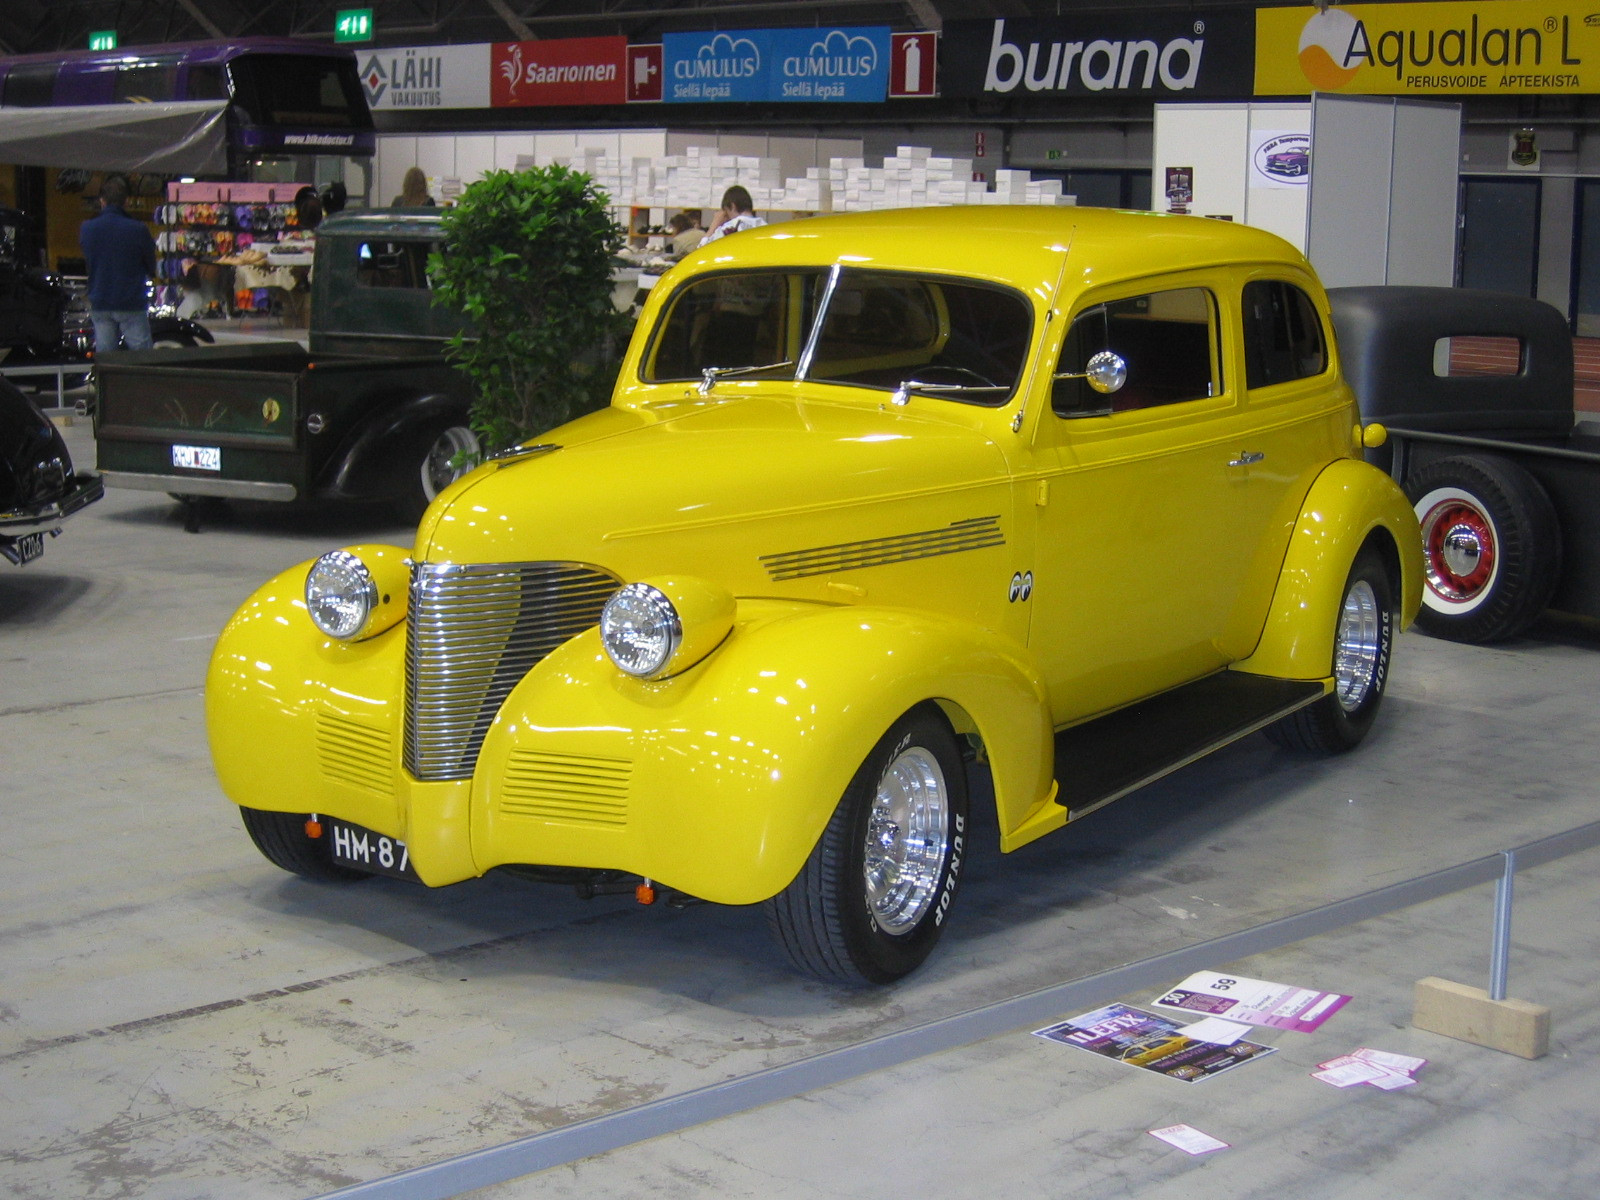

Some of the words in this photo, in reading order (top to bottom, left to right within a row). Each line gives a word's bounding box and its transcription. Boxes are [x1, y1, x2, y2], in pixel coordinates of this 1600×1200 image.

[1561, 15, 1581, 65] L
[391, 50, 441, 89] LÄHI
[525, 63, 616, 84] Saarioinen
[674, 57, 755, 78] CUMULUS
[782, 56, 872, 77] CUMULUS
[673, 83, 701, 98] Siellä
[702, 82, 731, 100] lepää
[782, 81, 812, 97] Siellä
[814, 81, 845, 100] lepää
[1406, 75, 1487, 88] PERUSVOIDE
[1499, 74, 1580, 88] APTEEKISTA
[391, 92, 441, 106] VAKUUTUS
[1375, 611, 1390, 693] DUNLOP
[333, 825, 409, 872] HM-87
[935, 813, 965, 926] DUNLOP
[1210, 978, 1237, 991] 59
